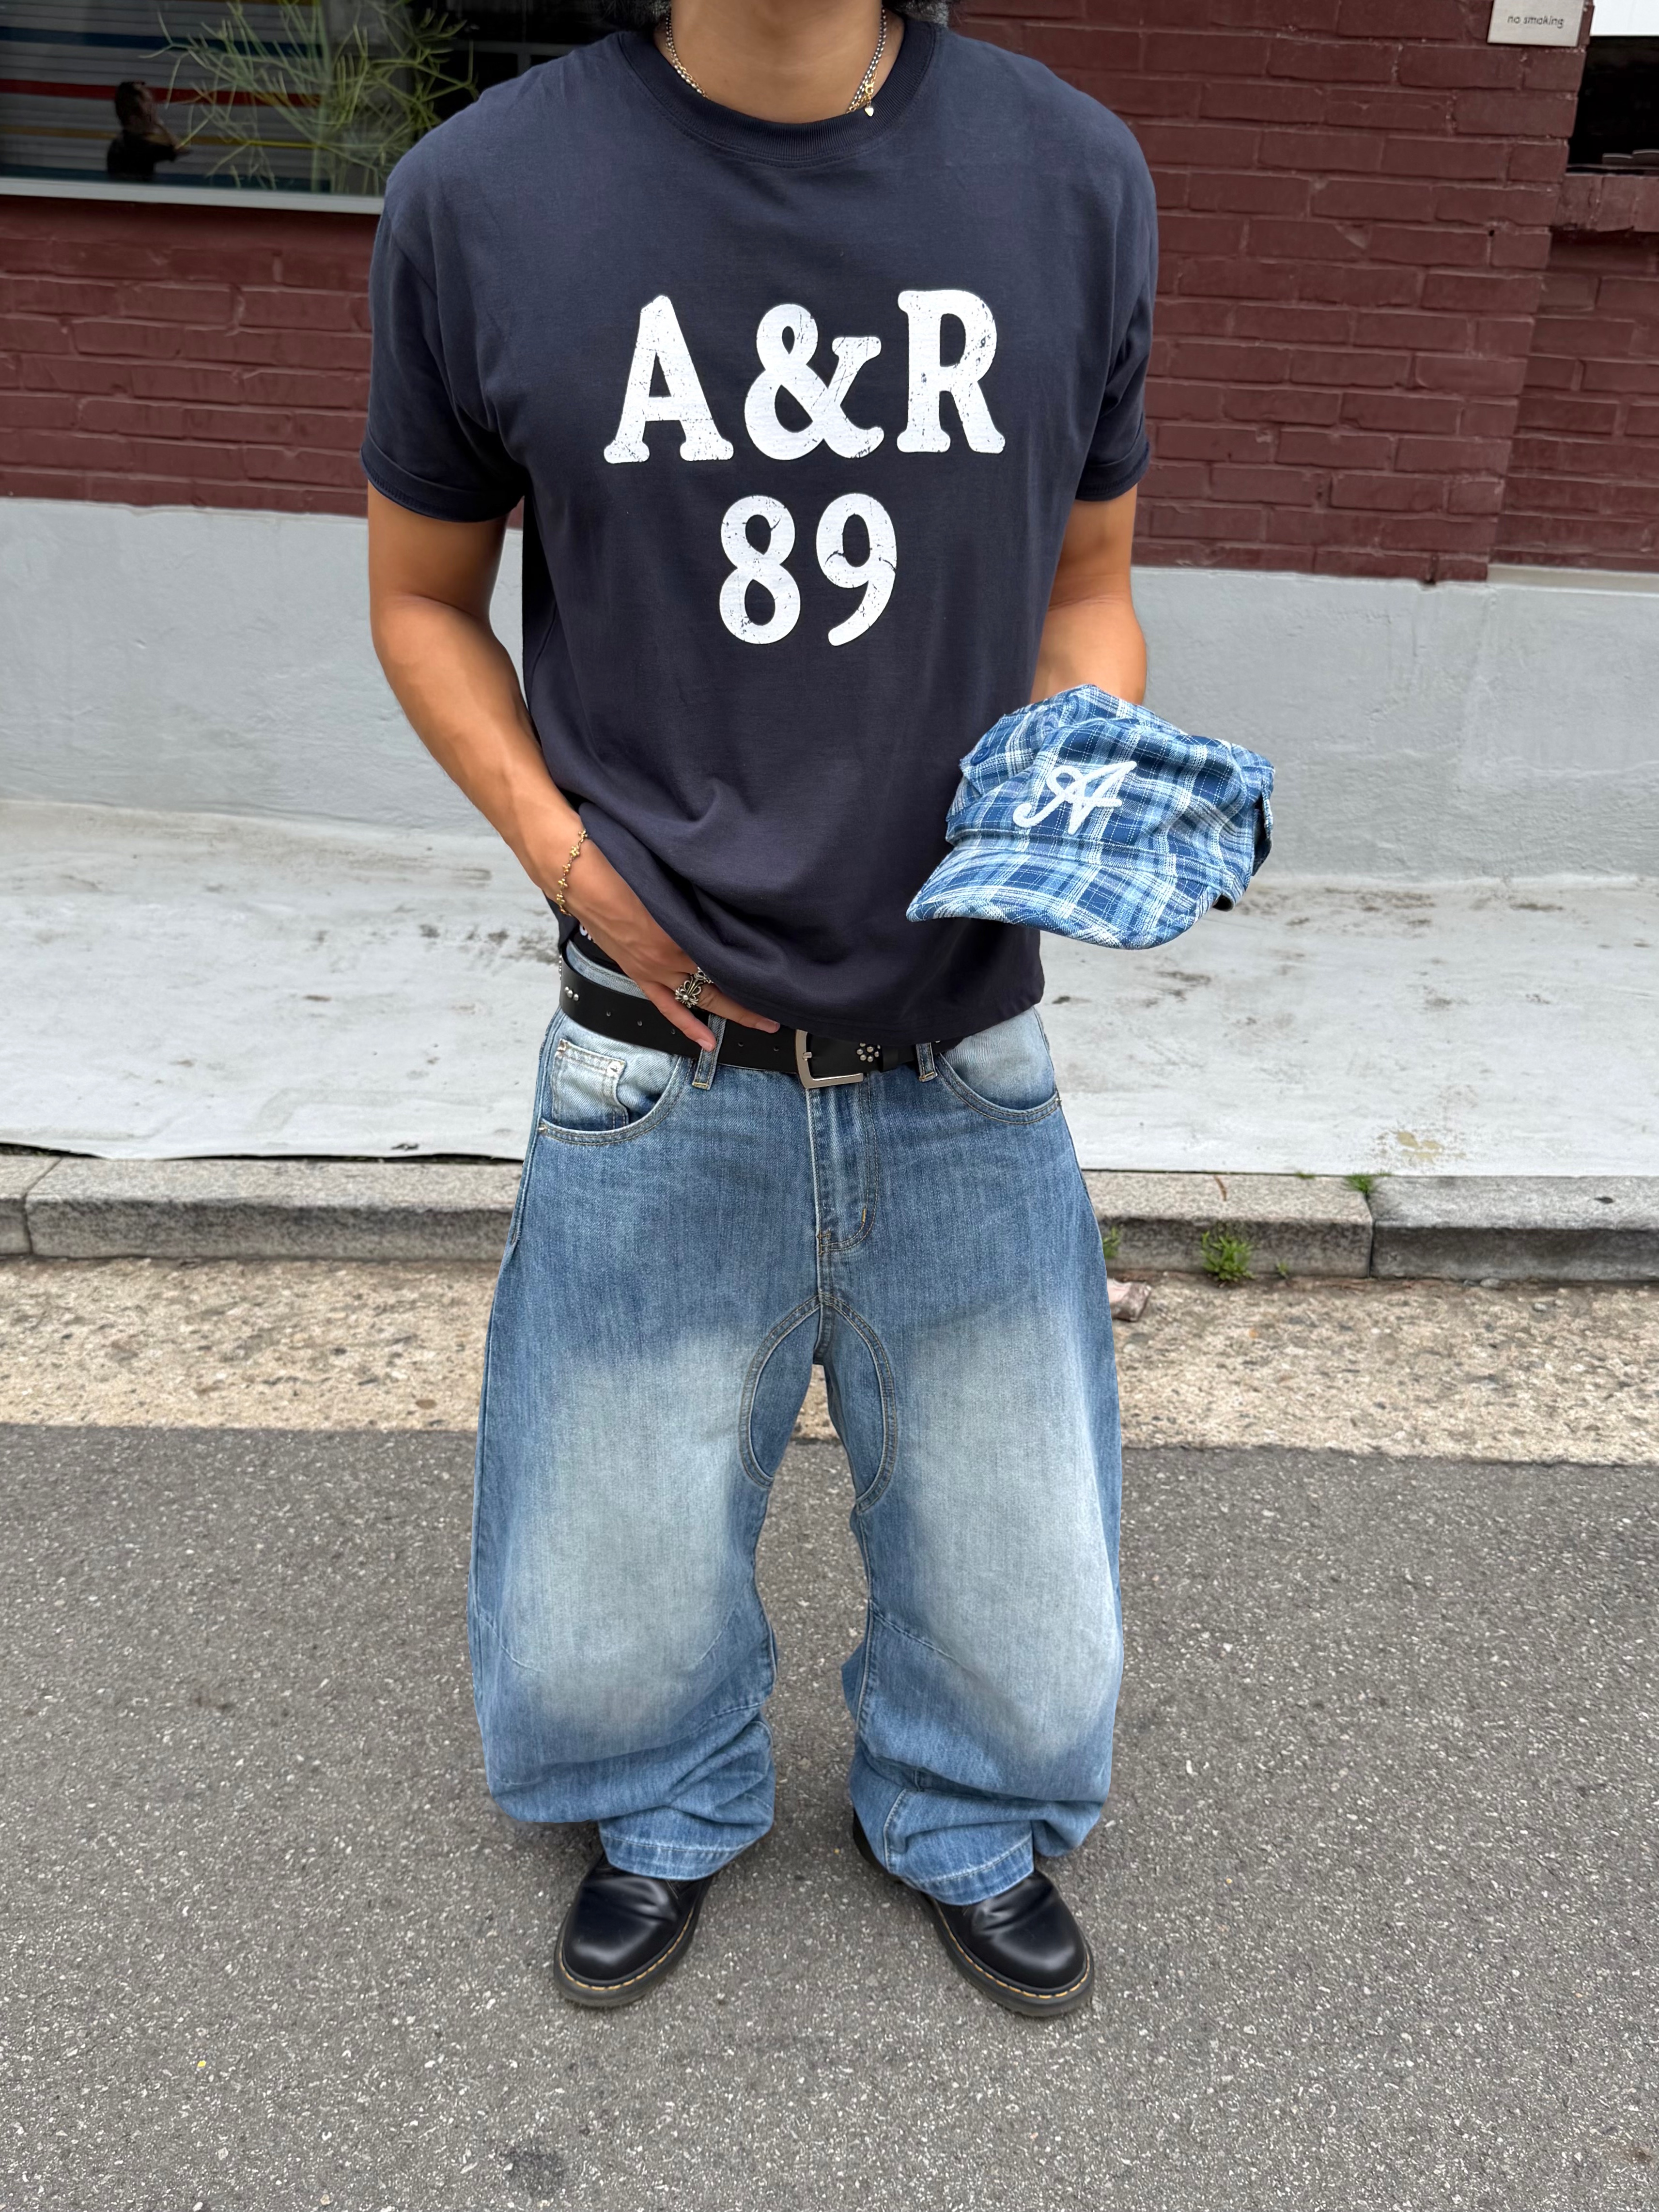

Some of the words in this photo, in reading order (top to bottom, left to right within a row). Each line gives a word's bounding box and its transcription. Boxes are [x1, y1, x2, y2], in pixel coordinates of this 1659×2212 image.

[1507, 16, 1521, 24] no
[1523, 16, 1564, 29] smoking
[604, 289, 1006, 464] A&R
[719, 493, 897, 646] 89
